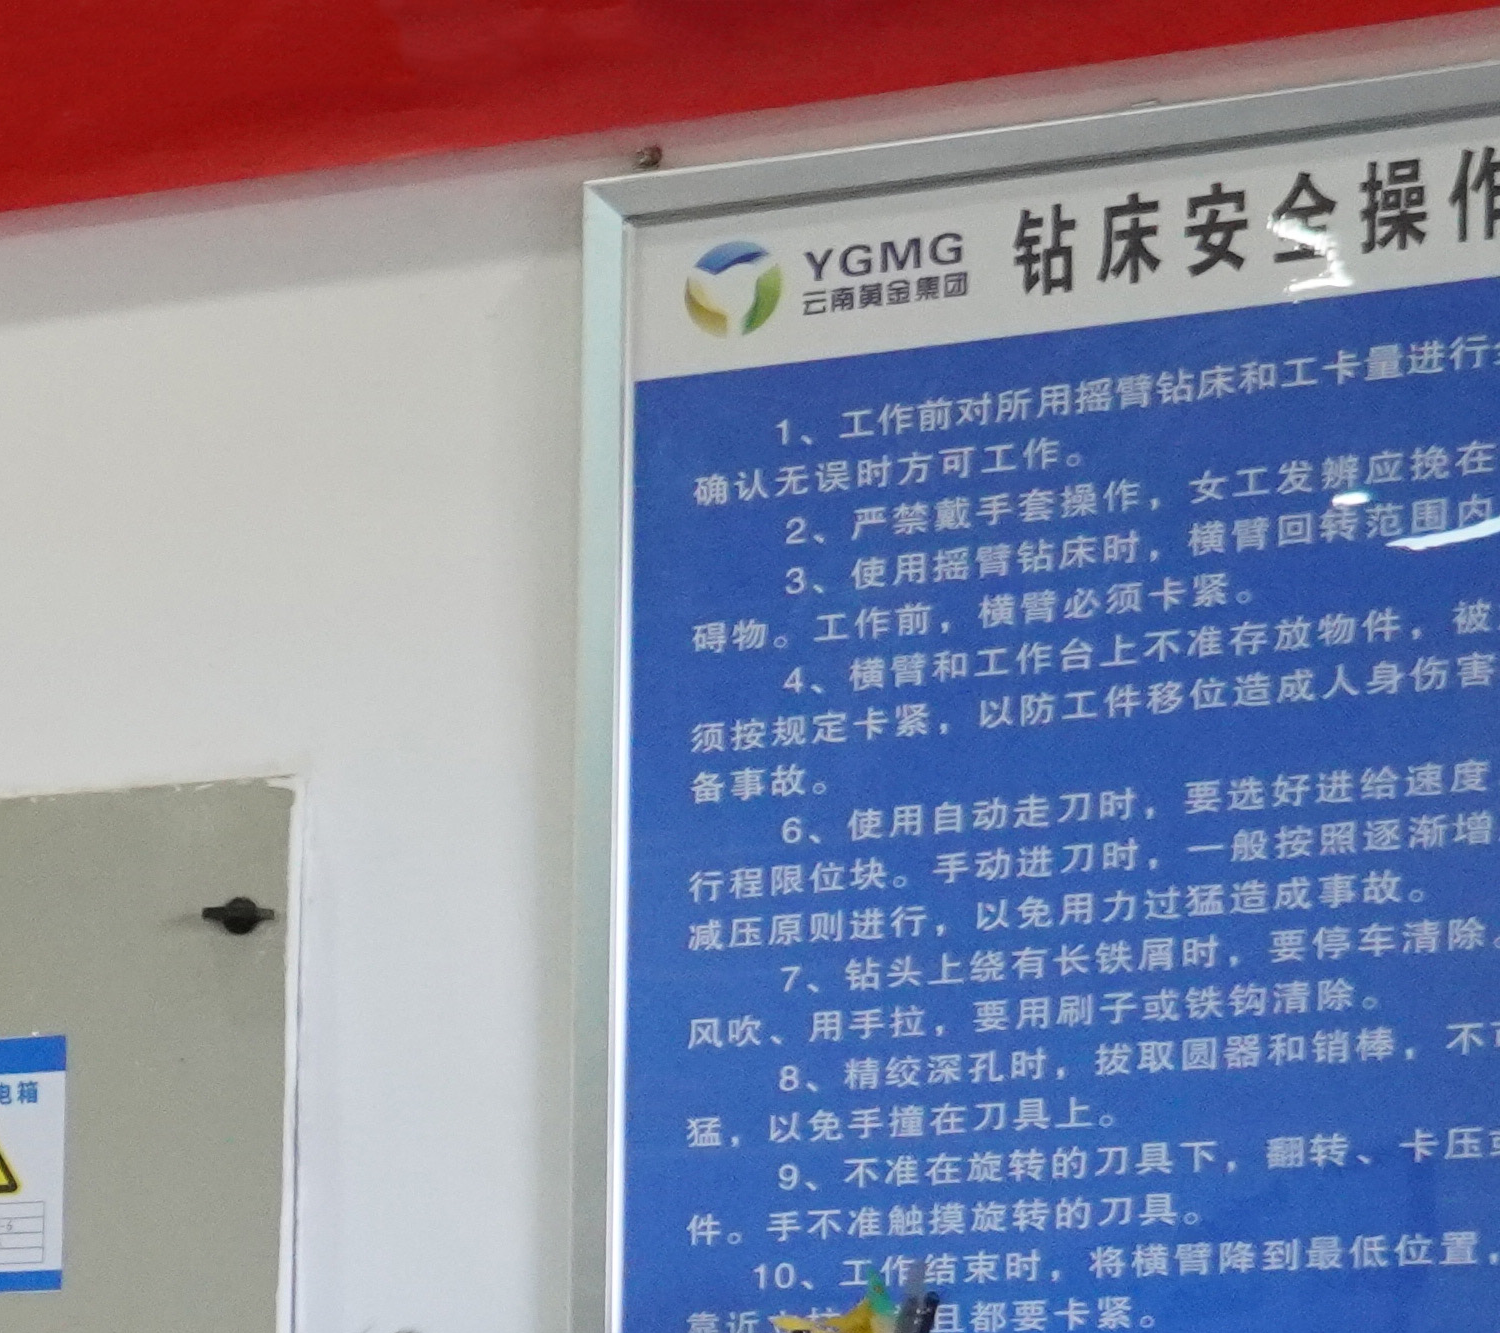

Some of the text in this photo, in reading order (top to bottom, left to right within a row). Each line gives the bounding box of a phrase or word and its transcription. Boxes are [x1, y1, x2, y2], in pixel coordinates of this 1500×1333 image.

[803, 231, 965, 283] YGMG
[802, 270, 969, 317] 云南黄金集团
[776, 335, 1500, 446] 1、工作前对所用摇臂钻床和工卡量进行
[693, 437, 1086, 506] 确认无误时方可工作。
[692, 572, 1254, 653] 碍物。工作前，横臂必须卡紧。
[691, 652, 1495, 753] 须按规定卡紧，以防工件移位造成人身伤害
[691, 763, 830, 804] 备事故。
[688, 870, 1426, 951] 减压原则进行，以免用力过猛造成事故。
[688, 978, 1381, 1050] 风吹、用手拉，要用刷子或铁钩清除。
[687, 1096, 1117, 1148] 猛，以免手撞在刀具上。
[686, 1193, 1204, 1246] 件。手不准触摸旋转的刀具。
